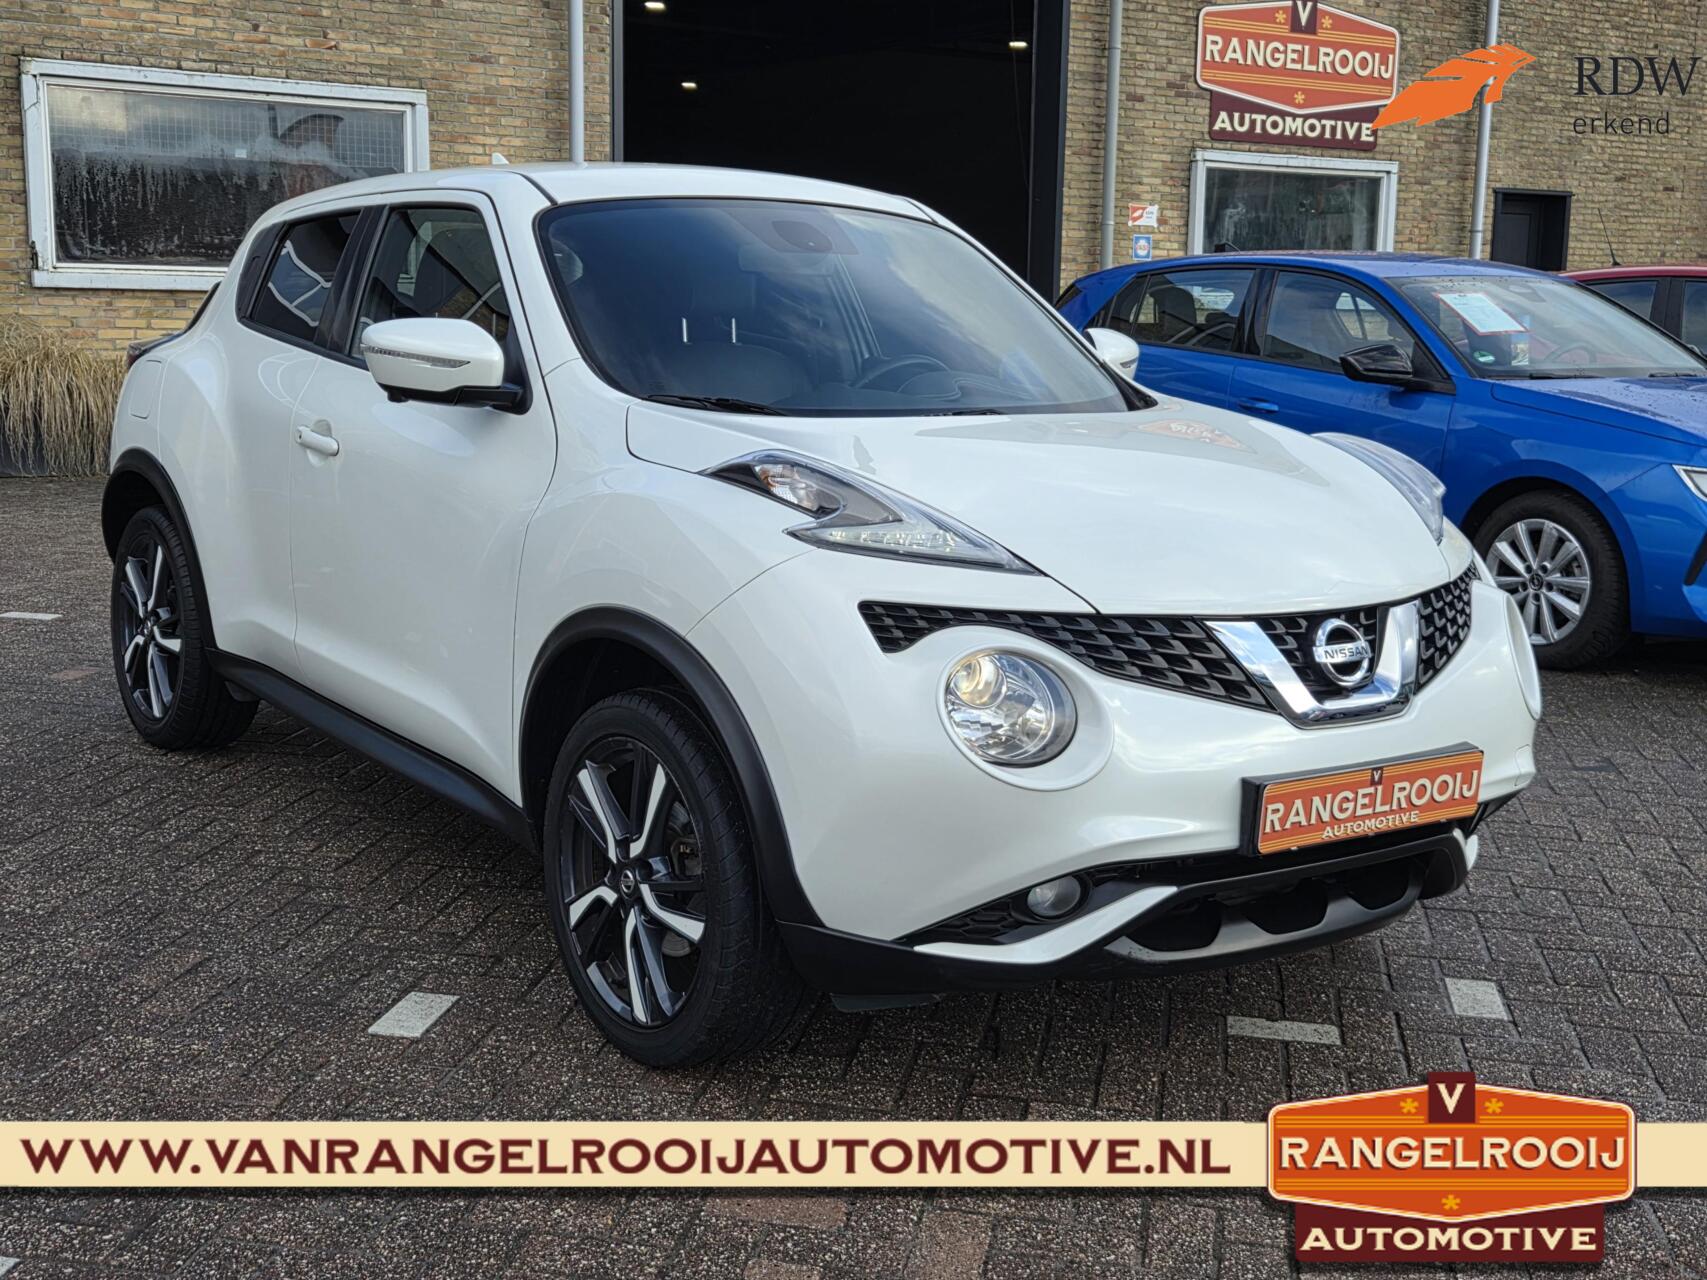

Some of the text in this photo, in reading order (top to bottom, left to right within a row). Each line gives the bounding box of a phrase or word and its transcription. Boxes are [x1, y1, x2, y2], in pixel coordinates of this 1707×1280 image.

[1297, 1, 1314, 27] V
[1204, 34, 1394, 79] RANGELROOIJ
[1212, 111, 1375, 142] AUTOMOTIVE
[1324, 645, 1369, 660] NISSAN
[1372, 769, 1382, 782] V
[1264, 769, 1480, 834] RANGELROOIJ
[1321, 810, 1420, 840] AUTOMOTIVE
